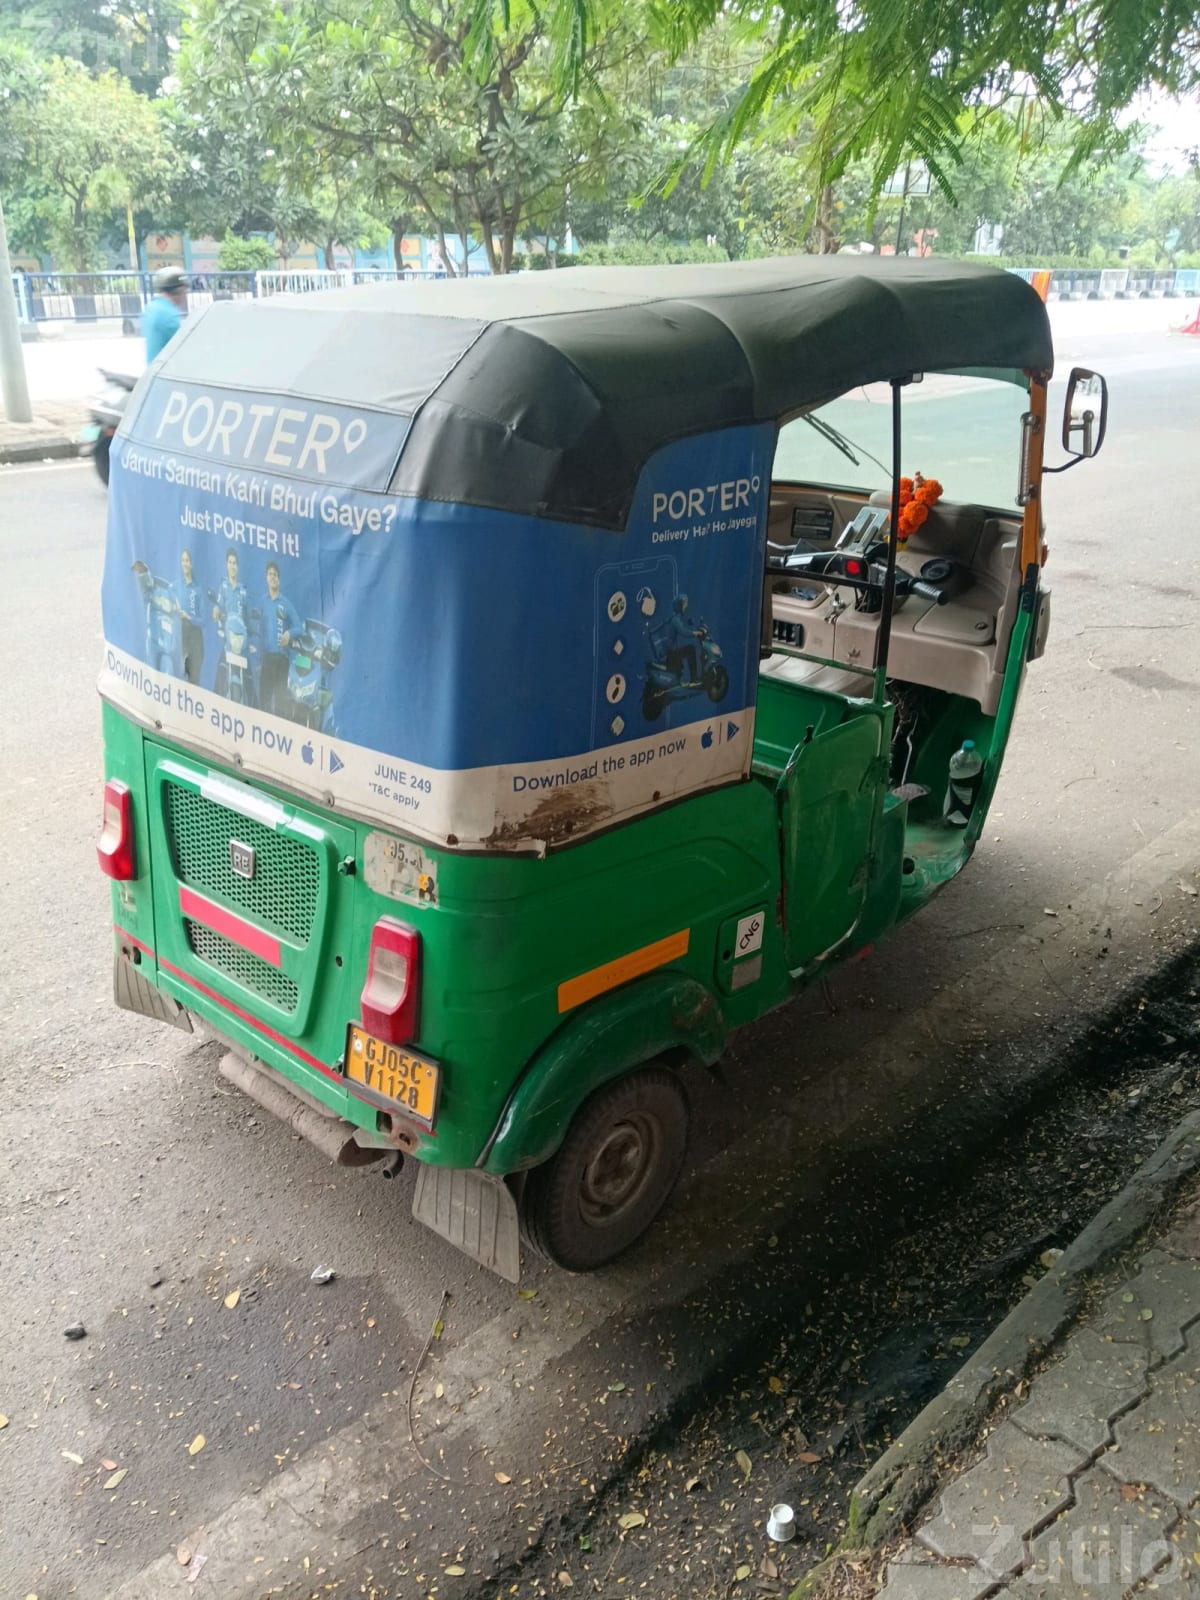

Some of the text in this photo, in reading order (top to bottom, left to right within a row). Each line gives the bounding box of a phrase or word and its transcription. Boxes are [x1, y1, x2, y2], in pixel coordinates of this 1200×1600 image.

[155, 390, 341, 474] PORTER
[120, 447, 397, 535] Jaruri Saman Kahi Bhul Gaye?
[652, 478, 750, 523] PORTER
[180, 505, 300, 558] Just PORTER It!
[651, 529, 689, 544] Delivery
[712, 520, 726, 534] Ho
[107, 651, 293, 755] Download the app now
[374, 764, 432, 793] JUNE 249
[513, 738, 686, 792] Download the app now
[393, 792, 420, 810] apply
[233, 852, 249, 872] RE
[739, 919, 760, 950] CNG
[364, 1061, 419, 1109] V1128
[366, 1037, 422, 1085] GJ05C
